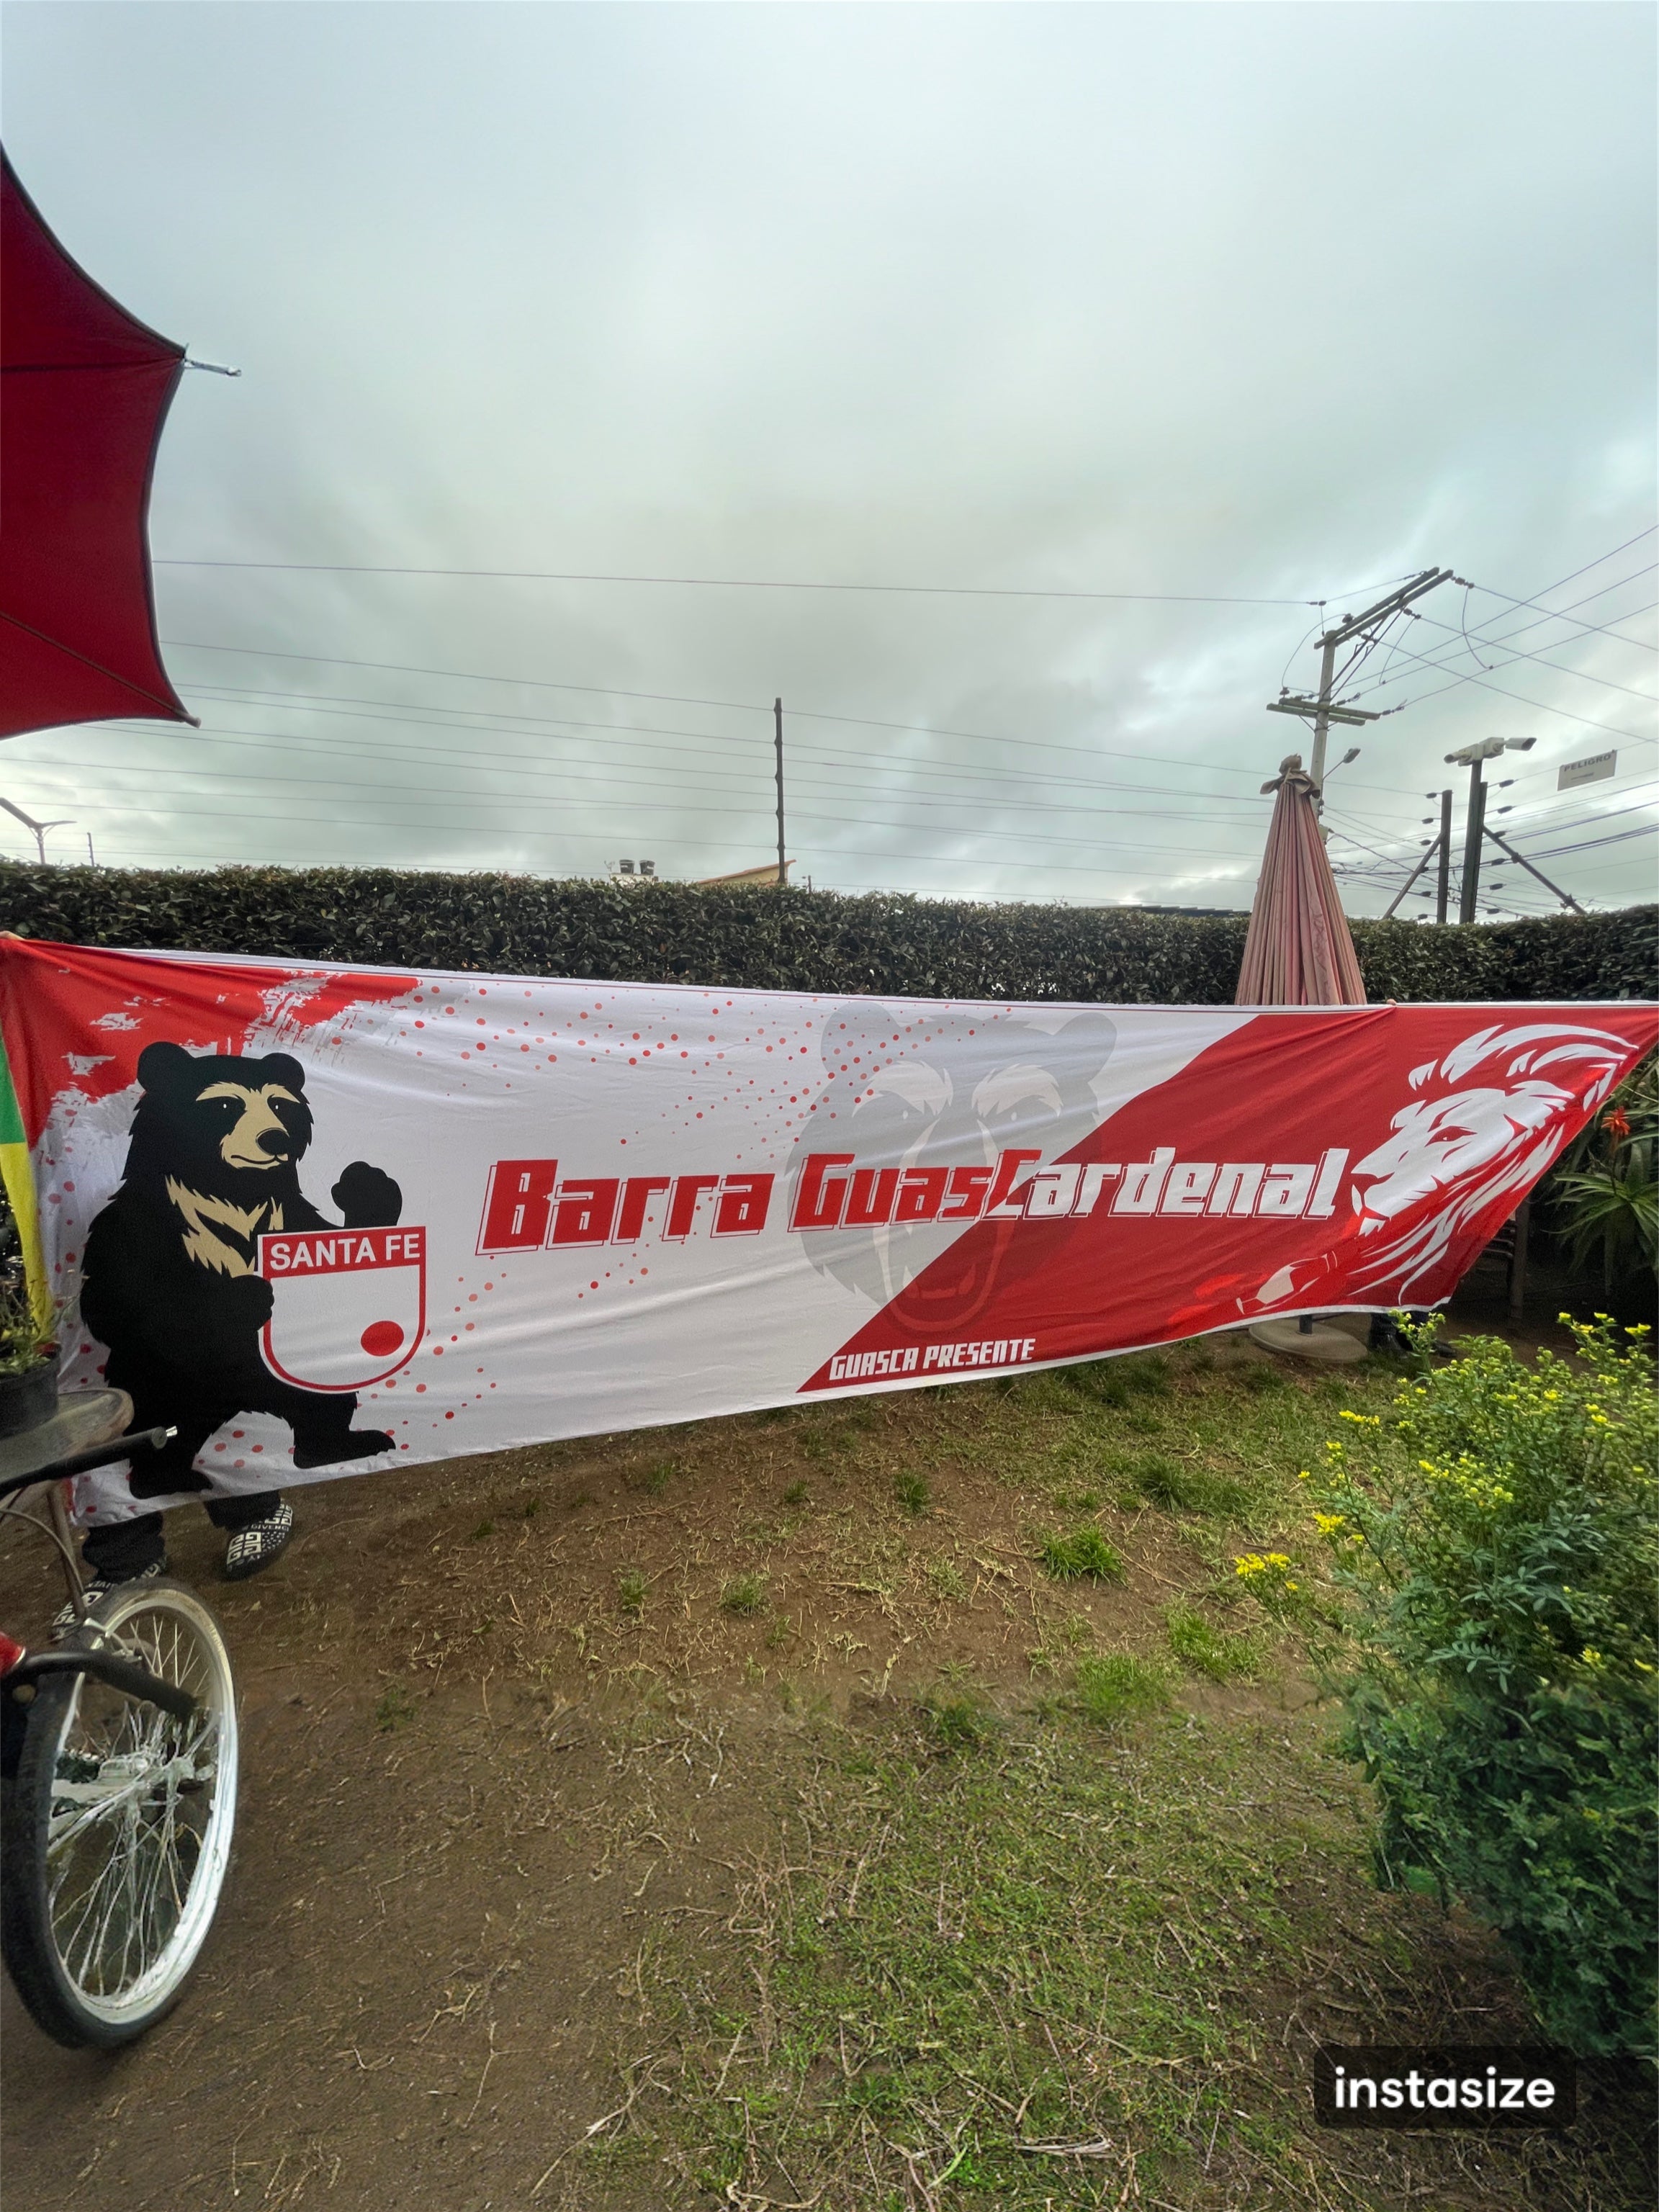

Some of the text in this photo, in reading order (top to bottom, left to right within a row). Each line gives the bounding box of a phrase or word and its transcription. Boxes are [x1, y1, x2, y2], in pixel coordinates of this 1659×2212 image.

[1563, 754, 1611, 772] PELIGRO
[475, 1159, 775, 1256] Barra
[270, 1233, 421, 1270] SANTA FE
[829, 1339, 1036, 1380] GUASCA PRESENTE
